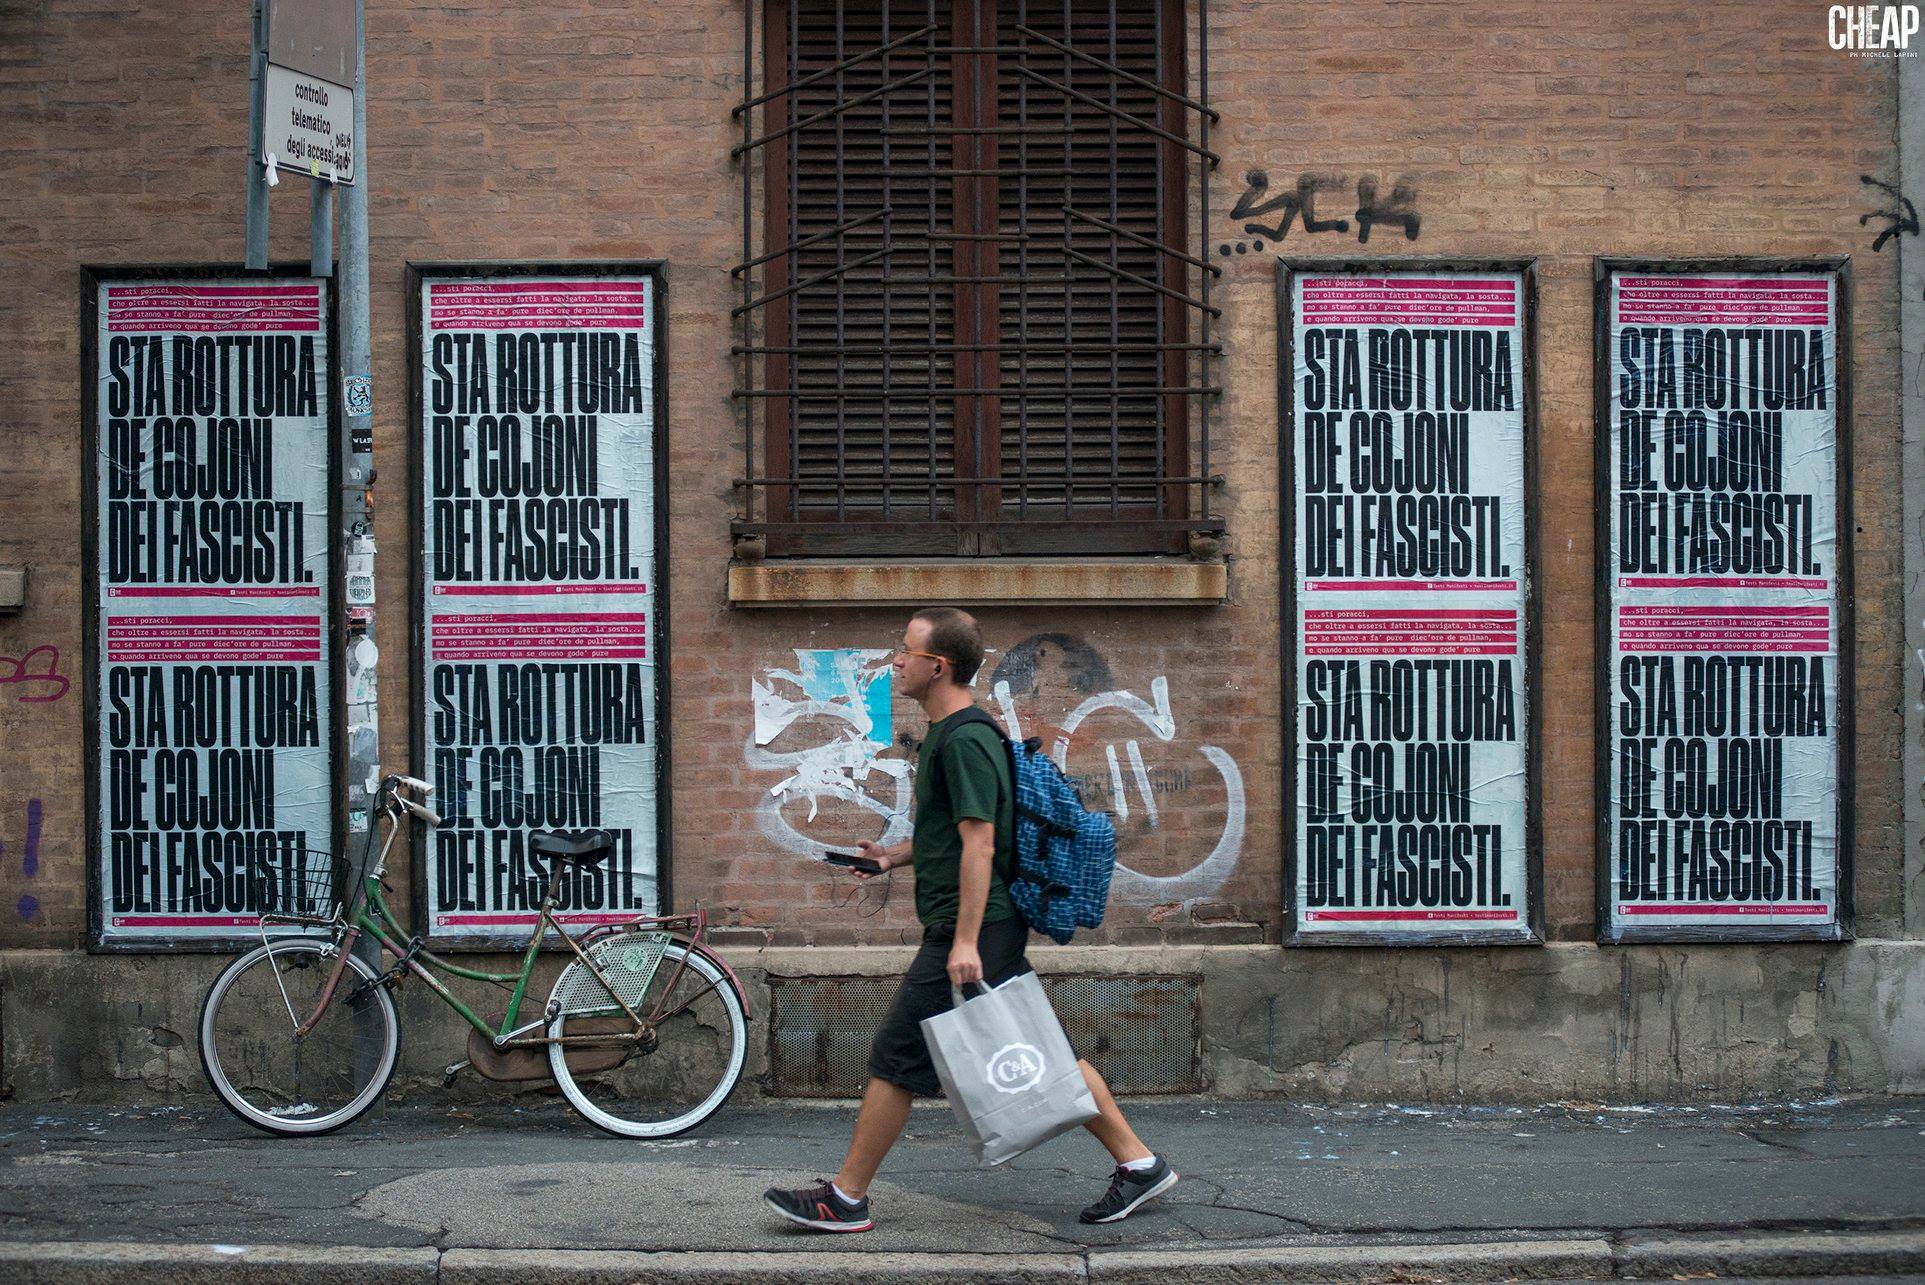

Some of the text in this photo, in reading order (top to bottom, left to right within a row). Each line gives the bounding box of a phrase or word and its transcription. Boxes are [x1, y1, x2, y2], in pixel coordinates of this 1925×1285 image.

[291, 107, 331, 135] telematico
[295, 83, 329, 107] controllo
[286, 134, 306, 160] degli
[109, 336, 165, 417] STA
[173, 336, 317, 417] ROTTURA
[433, 333, 489, 413] STA
[497, 333, 642, 413] ROTTURA
[1305, 329, 1513, 410] STA ROTTURA
[1620, 328, 1826, 409] STA ROTTURA
[109, 418, 272, 499] DE COJONI
[433, 415, 597, 497] DE COJONI
[1305, 412, 1468, 493] DE COJONI
[1620, 410, 1782, 491] DE COJONI
[109, 501, 313, 582] DEI FASCISTI.
[434, 499, 638, 581] DEI FASCISTI.
[1306, 495, 1509, 577] DEI FASCISTI.
[1620, 493, 1820, 574] DEI FASCISTI.
[120, 653, 145, 661] quando
[444, 651, 470, 660] quando
[1316, 646, 1343, 655] quando
[1410, 646, 1436, 654] devono
[1463, 647, 1481, 655] pure
[1325, 623, 1346, 631] oltre
[1468, 622, 1477, 631] la
[1386, 635, 1403, 643] pure
[110, 666, 166, 747] STA
[174, 666, 318, 747] ROTTURA
[434, 663, 645, 745] STA ROTTURA
[1307, 660, 1515, 741] STA ROTTURA
[1621, 656, 1827, 737] STA ROTTURA
[111, 749, 274, 830] DE COJONI
[435, 746, 600, 828] DE COJONI
[1307, 743, 1470, 824] DE COJONI
[1620, 738, 1782, 818] DE COJONI
[112, 831, 316, 912] DEI FASCISTI.
[437, 829, 485, 911] DEI
[1307, 825, 1510, 907] DEI FASCISTI.
[1620, 820, 1820, 901] DEI FASCISTI.
[996, 1053, 1038, 1083] C&A
